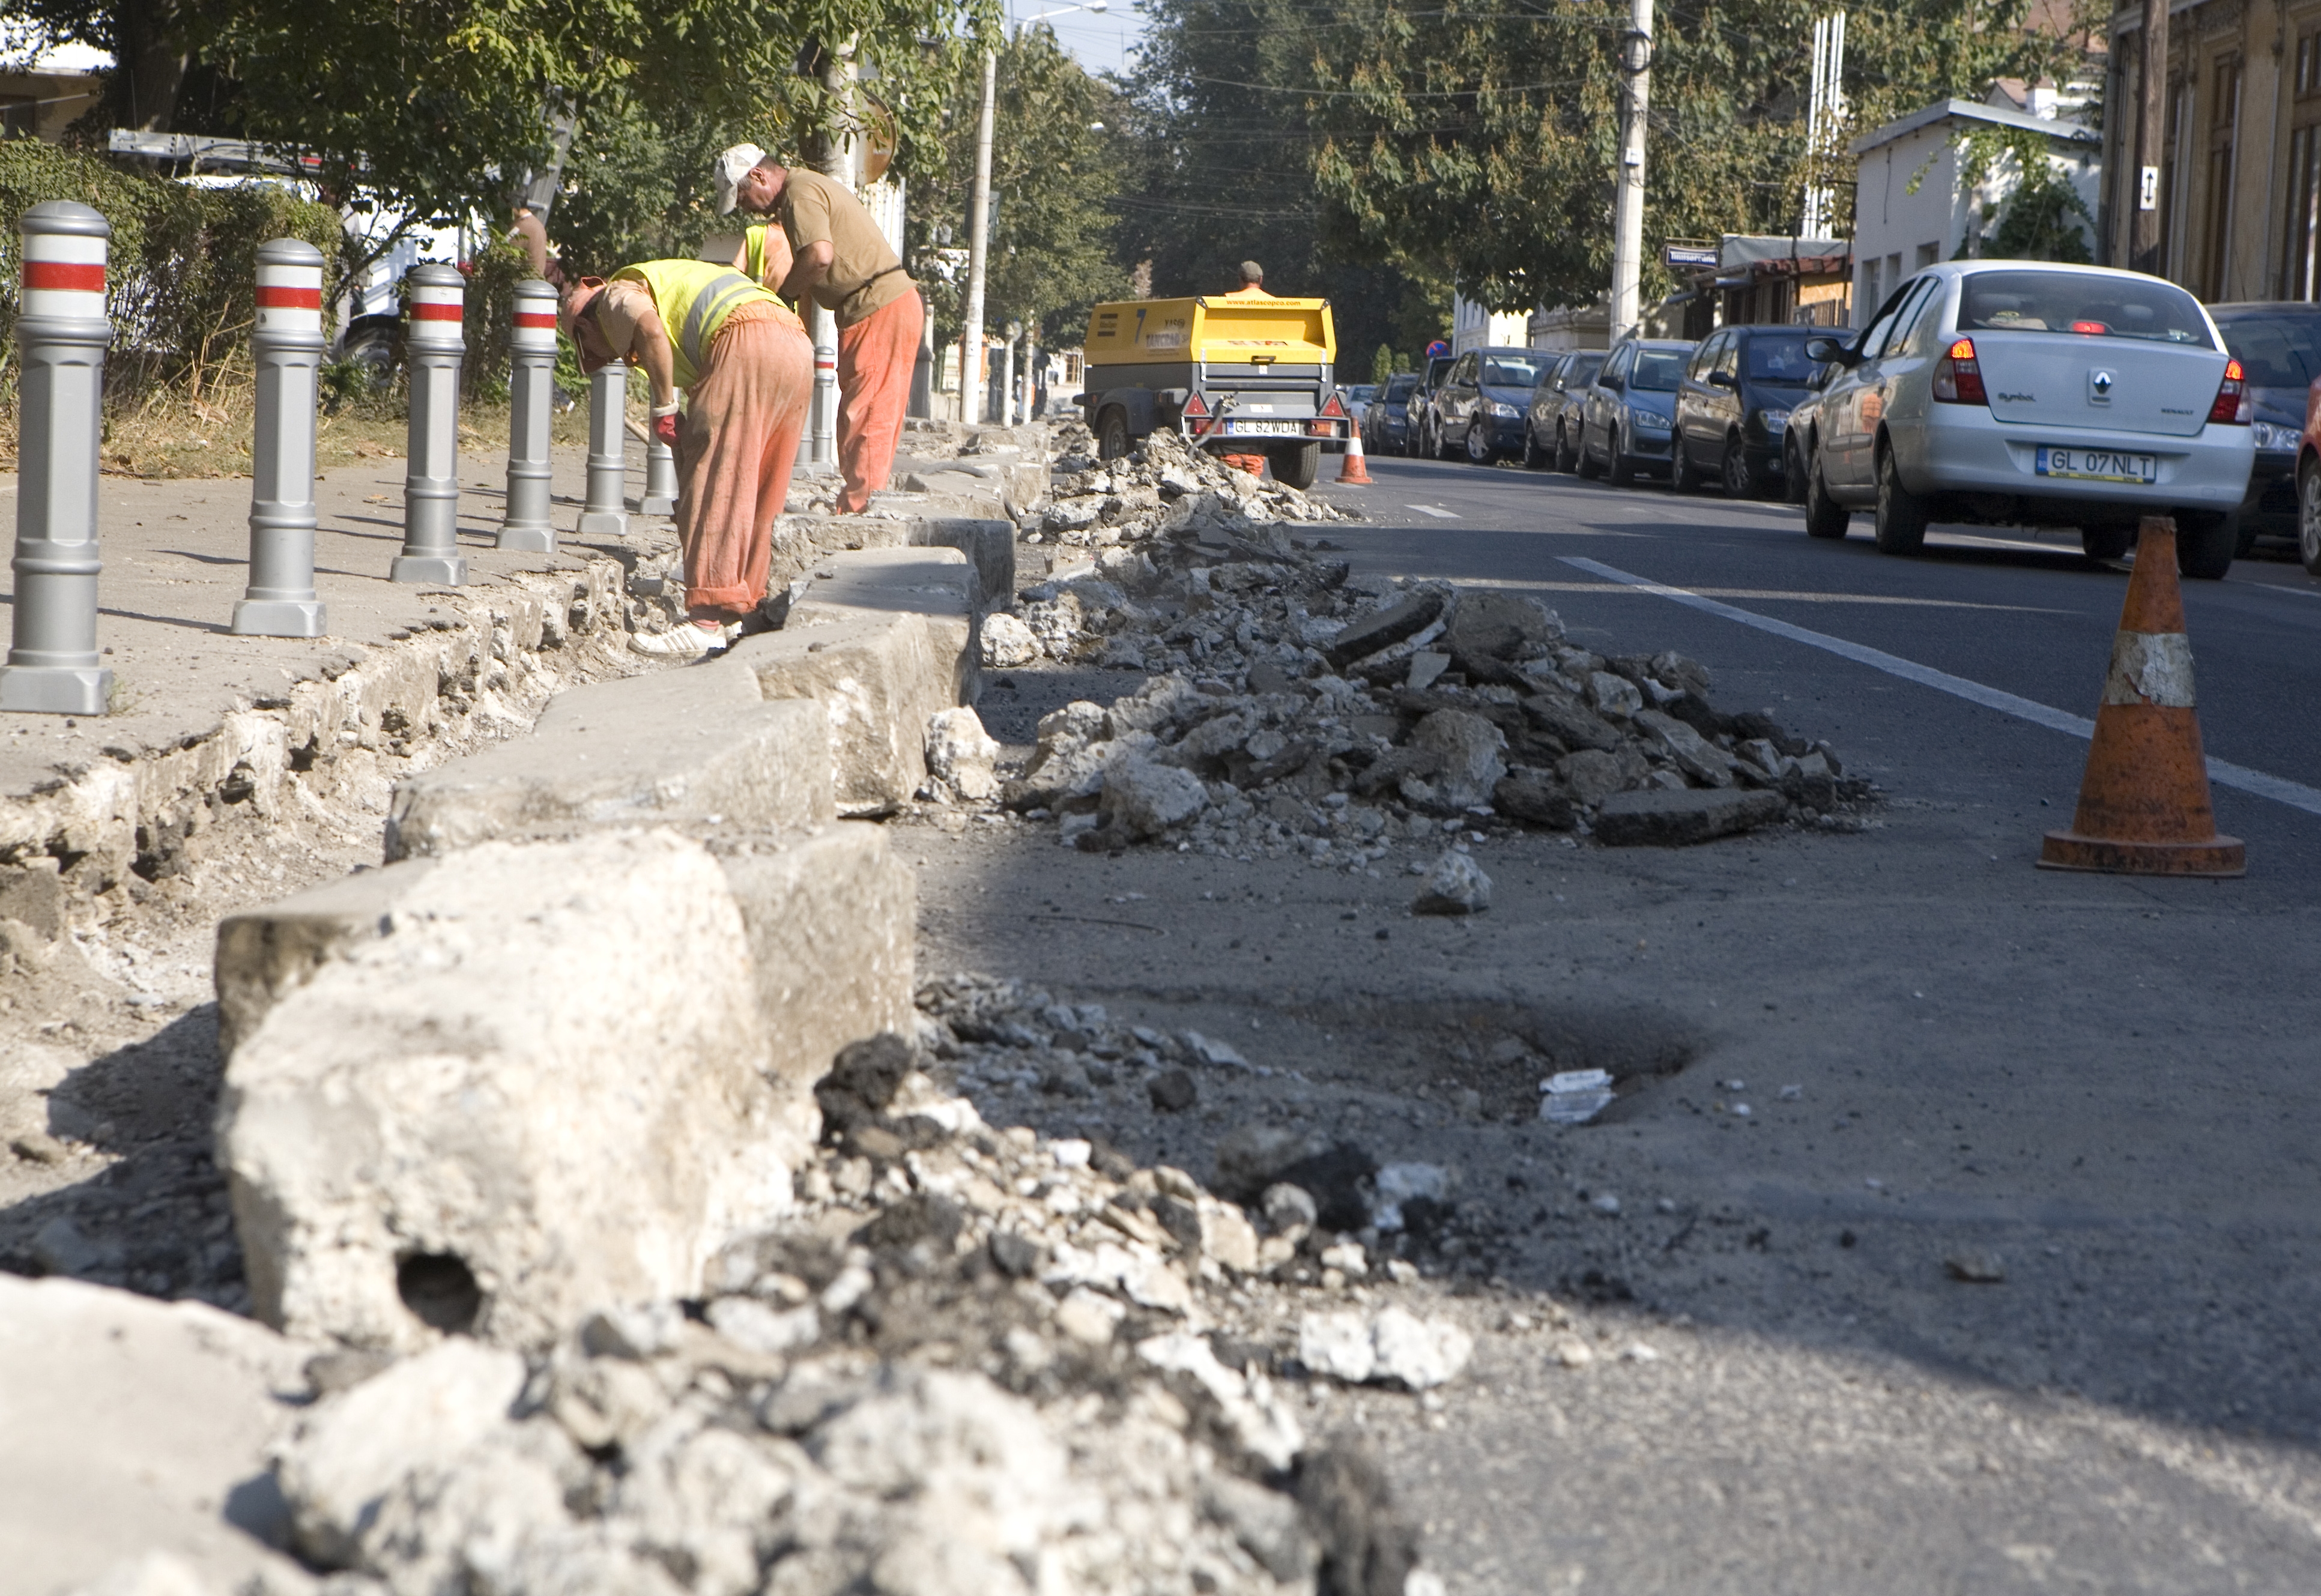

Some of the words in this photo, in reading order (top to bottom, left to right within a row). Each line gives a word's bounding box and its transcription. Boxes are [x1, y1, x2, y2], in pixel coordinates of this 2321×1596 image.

[1135, 309, 1146, 344] 7
[1235, 420, 1250, 433] GL
[1256, 421, 1297, 433] 82WDA
[2051, 451, 2077, 470] GL
[2086, 453, 2150, 476] 07NLT
